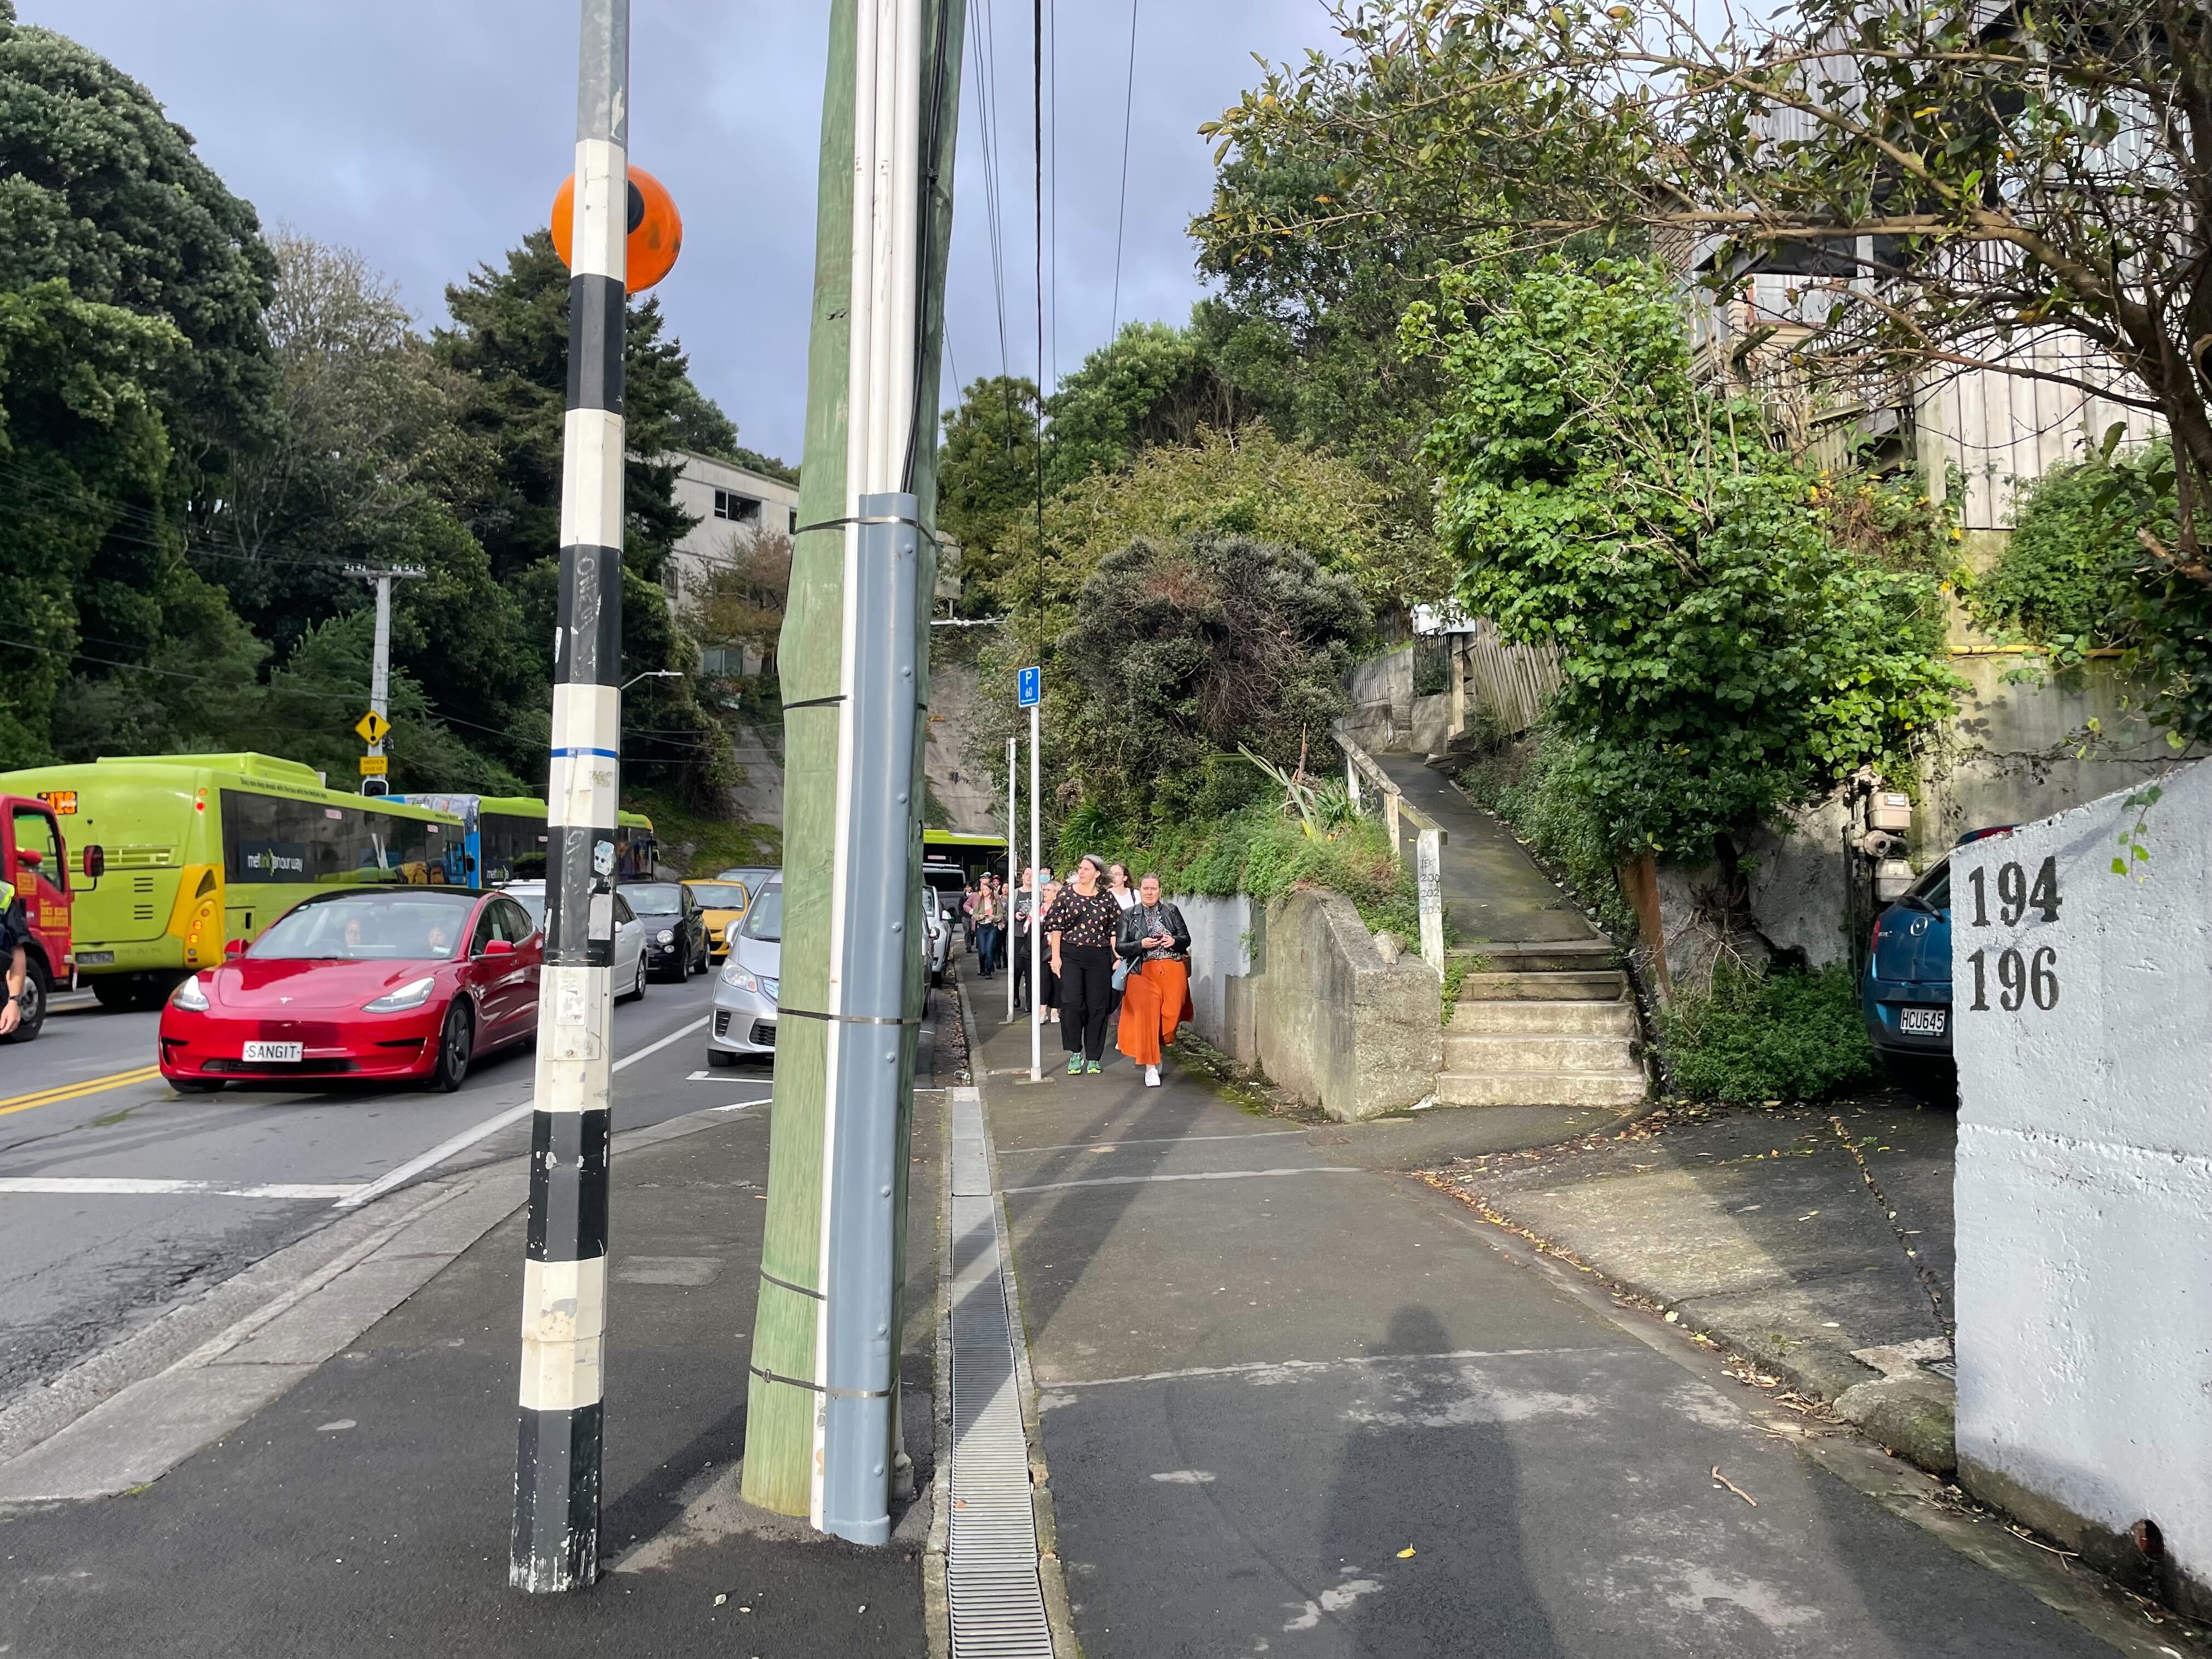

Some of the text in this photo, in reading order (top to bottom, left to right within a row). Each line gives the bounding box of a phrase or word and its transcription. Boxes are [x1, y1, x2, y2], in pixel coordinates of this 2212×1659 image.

[1026, 671, 1032, 685] P
[1025, 686, 1032, 698] 60
[1420, 873, 1440, 882] 200
[1420, 889, 1440, 898] 202
[1968, 856, 2063, 927] 194
[1421, 906, 1442, 915] 204
[1967, 946, 2059, 1011] 196
[1902, 1011, 1944, 1030] HCU645
[248, 1045, 297, 1058] SANGIT
